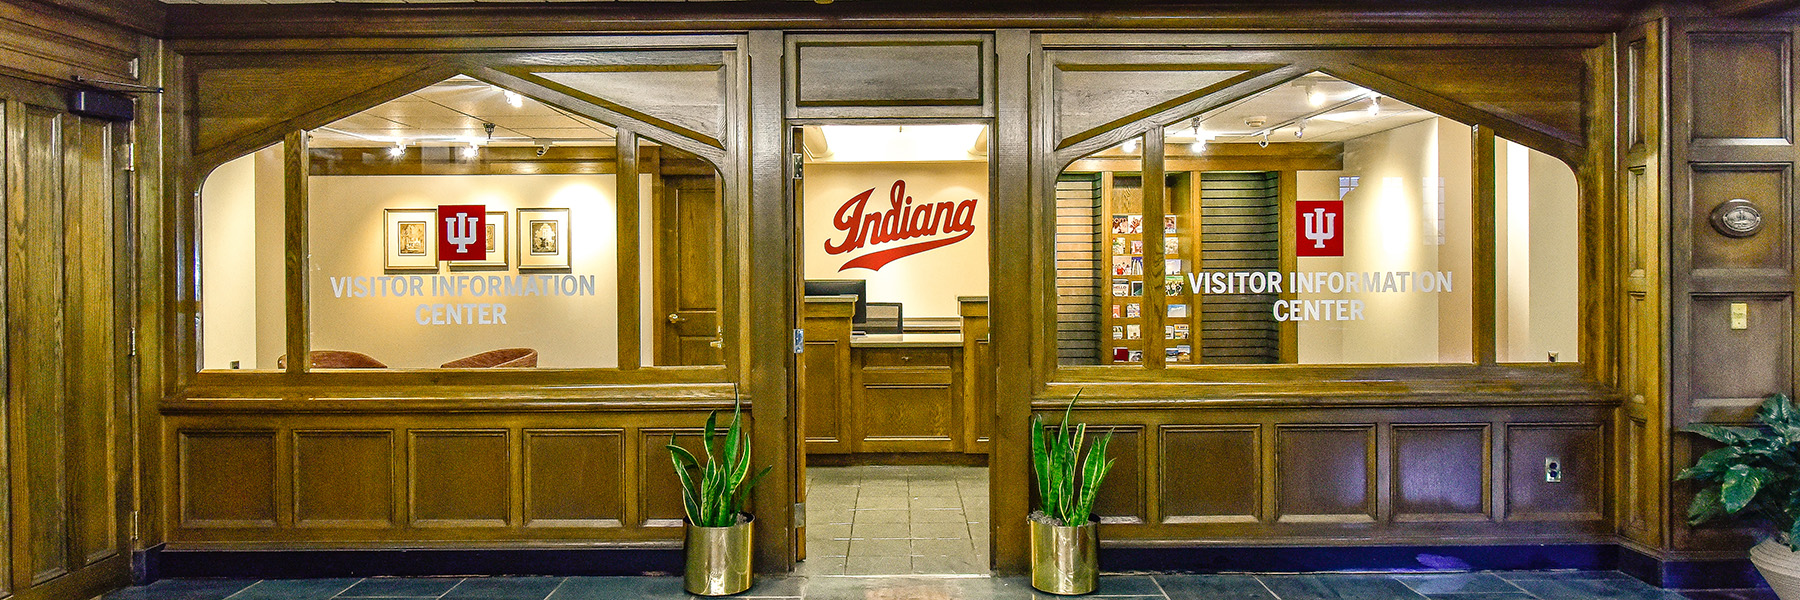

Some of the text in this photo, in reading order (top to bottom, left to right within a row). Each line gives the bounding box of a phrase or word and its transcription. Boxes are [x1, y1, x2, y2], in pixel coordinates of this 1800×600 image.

[824, 179, 978, 272] Indiana
[330, 274, 595, 298] VISITOR INFORMATION
[1188, 271, 1452, 294] VISITOR INFORMATION
[415, 303, 507, 325] CENTER
[1272, 299, 1365, 322] CENTER
